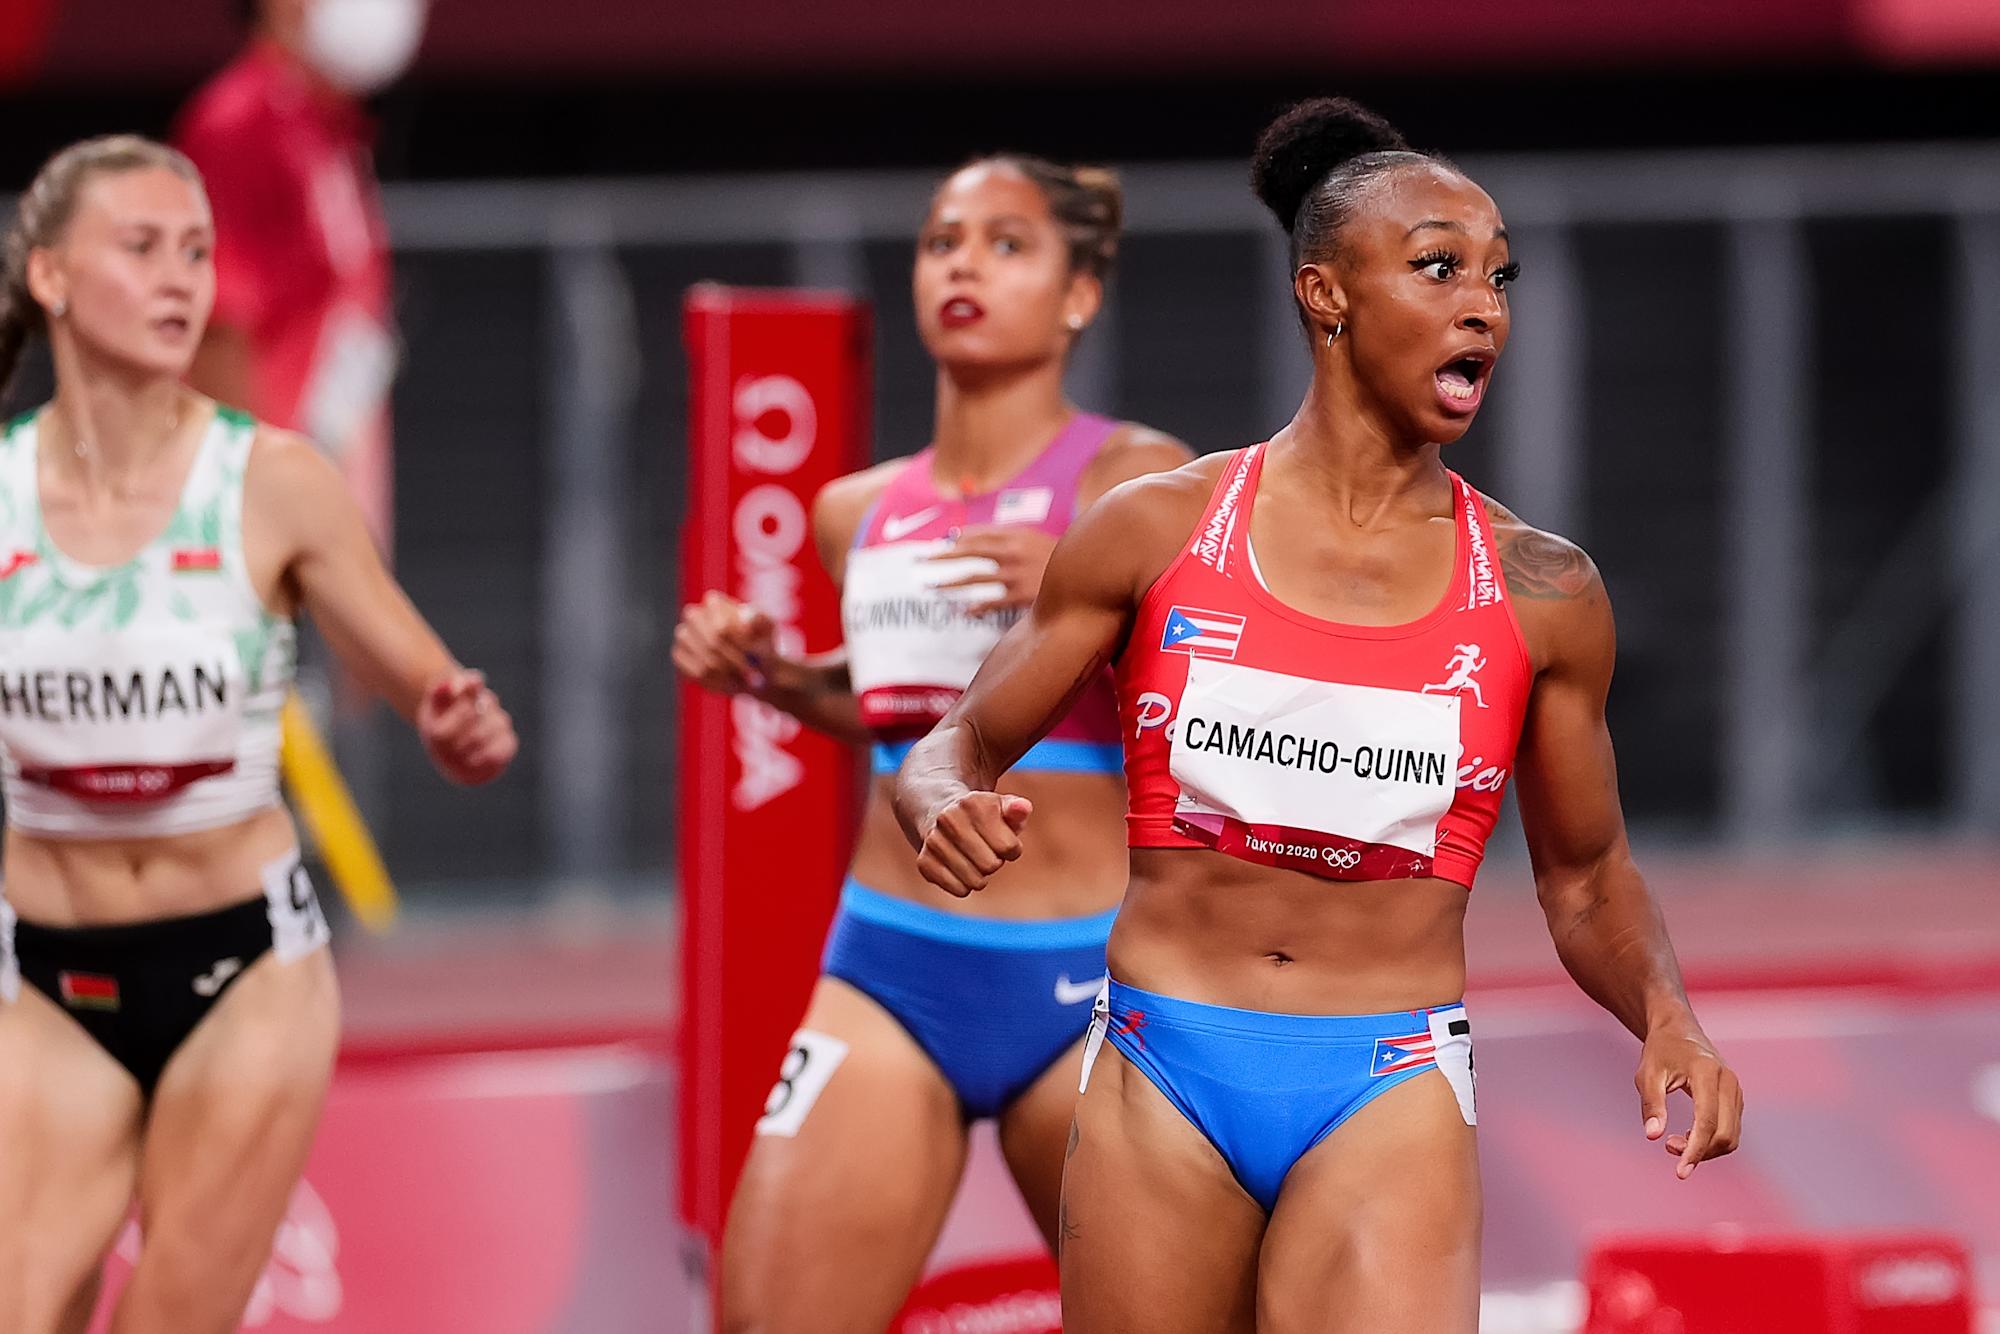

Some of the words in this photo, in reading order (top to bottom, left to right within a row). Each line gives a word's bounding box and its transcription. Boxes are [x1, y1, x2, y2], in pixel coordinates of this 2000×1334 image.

[0, 662, 227, 724] HERMAN
[1185, 717, 1446, 786] CAMACHO-QUINN
[1455, 742, 1507, 792] ico
[1245, 834, 1285, 855] TOKYO
[1286, 844, 1318, 860] 2020
